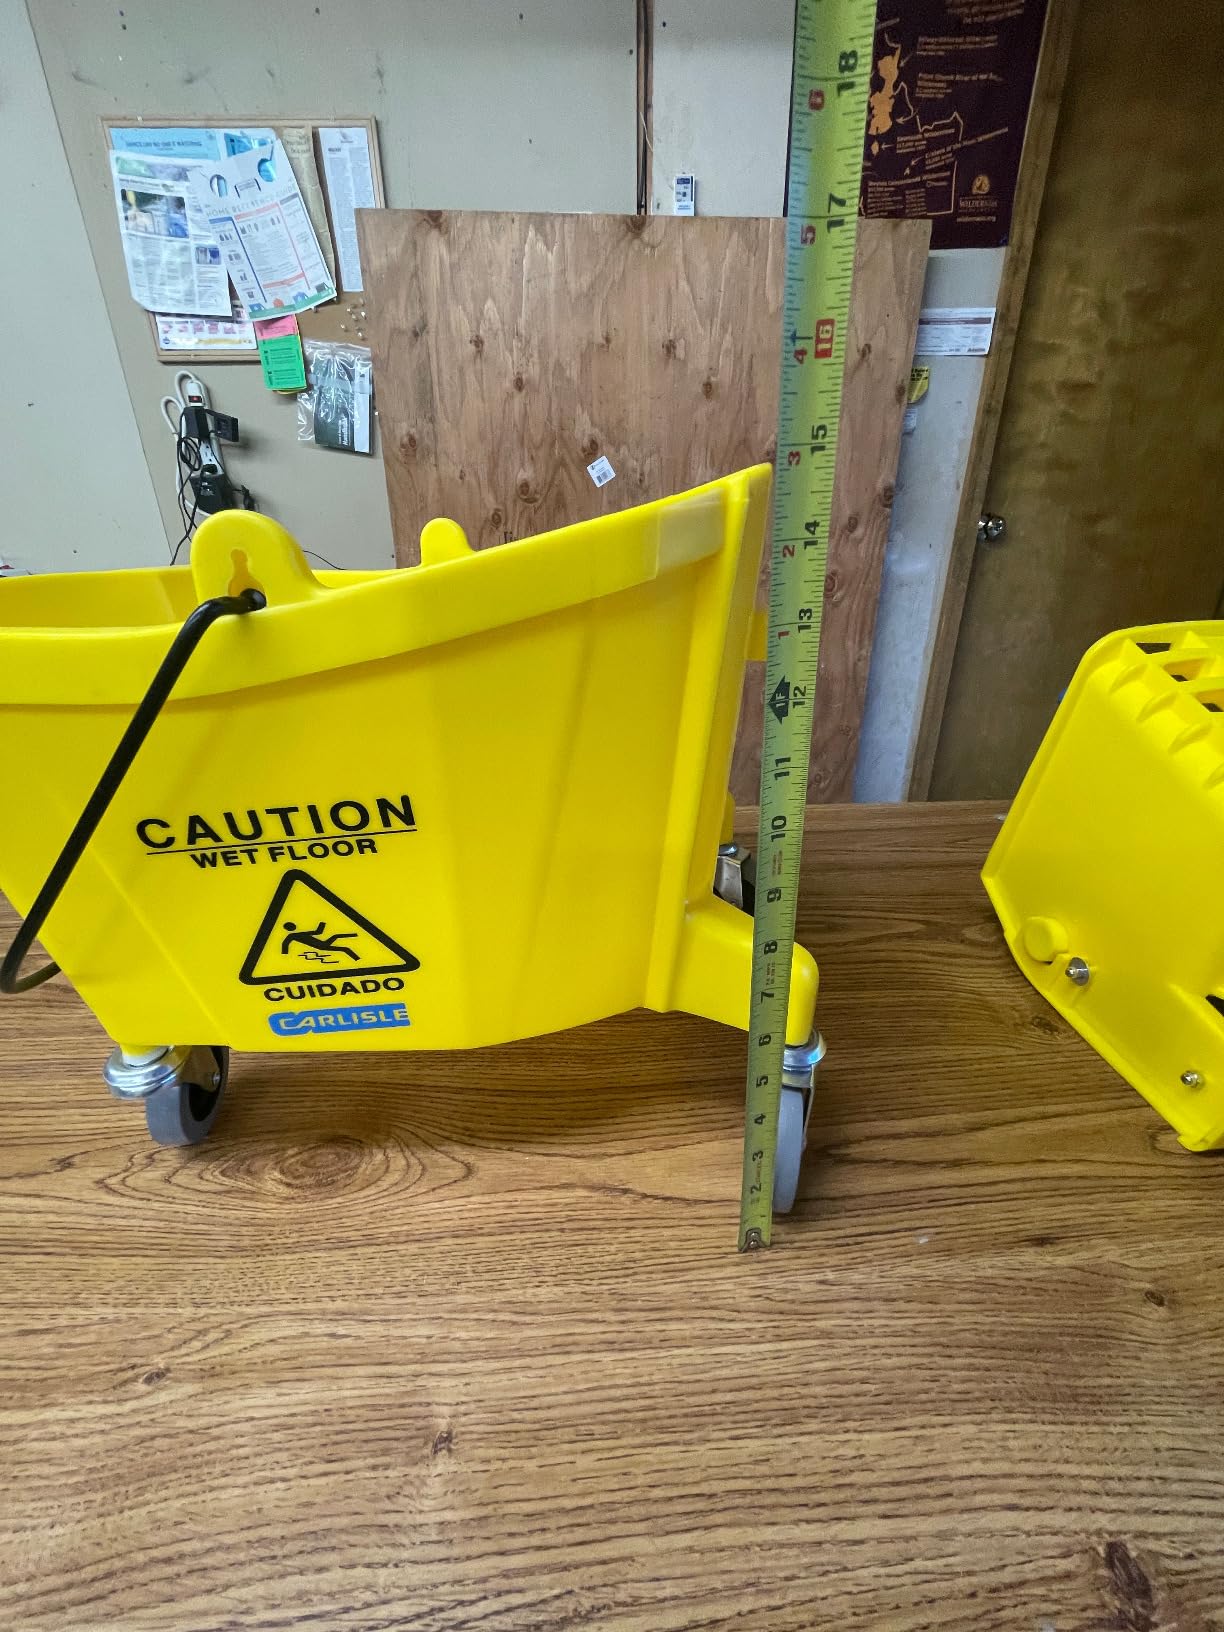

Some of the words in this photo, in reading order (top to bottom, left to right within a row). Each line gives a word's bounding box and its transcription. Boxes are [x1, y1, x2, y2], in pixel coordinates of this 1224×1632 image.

[836, 49, 859, 97] 18
[827, 192, 847, 234] 17
[800, 225, 817, 245] 5
[816, 322, 834, 353] 16
[793, 346, 808, 365] 4
[810, 423, 828, 456] 15
[787, 450, 801, 466] 3
[803, 519, 821, 550] 14
[782, 544, 796, 558] 2
[797, 607, 813, 634] 13
[777, 630, 790, 640] 1
[792, 685, 807, 709] 12
[774, 756, 792, 781] 11
[135, 794, 417, 850] CAUTION
[771, 815, 787, 842] 10
[189, 848, 259, 869] WET
[269, 838, 378, 863] FLOOR
[766, 887, 782, 903] 9
[763, 940, 778, 955] 8
[263, 977, 405, 1002] CUIDADO
[760, 990, 775, 1006] 7
[278, 1008, 410, 1031] CARLISLE
[758, 1033, 772, 1047] 6
[755, 1075, 769, 1088] 5
[753, 1112, 766, 1126] 4
[751, 1150, 764, 1161] 3
[750, 1182, 762, 1193] 2
